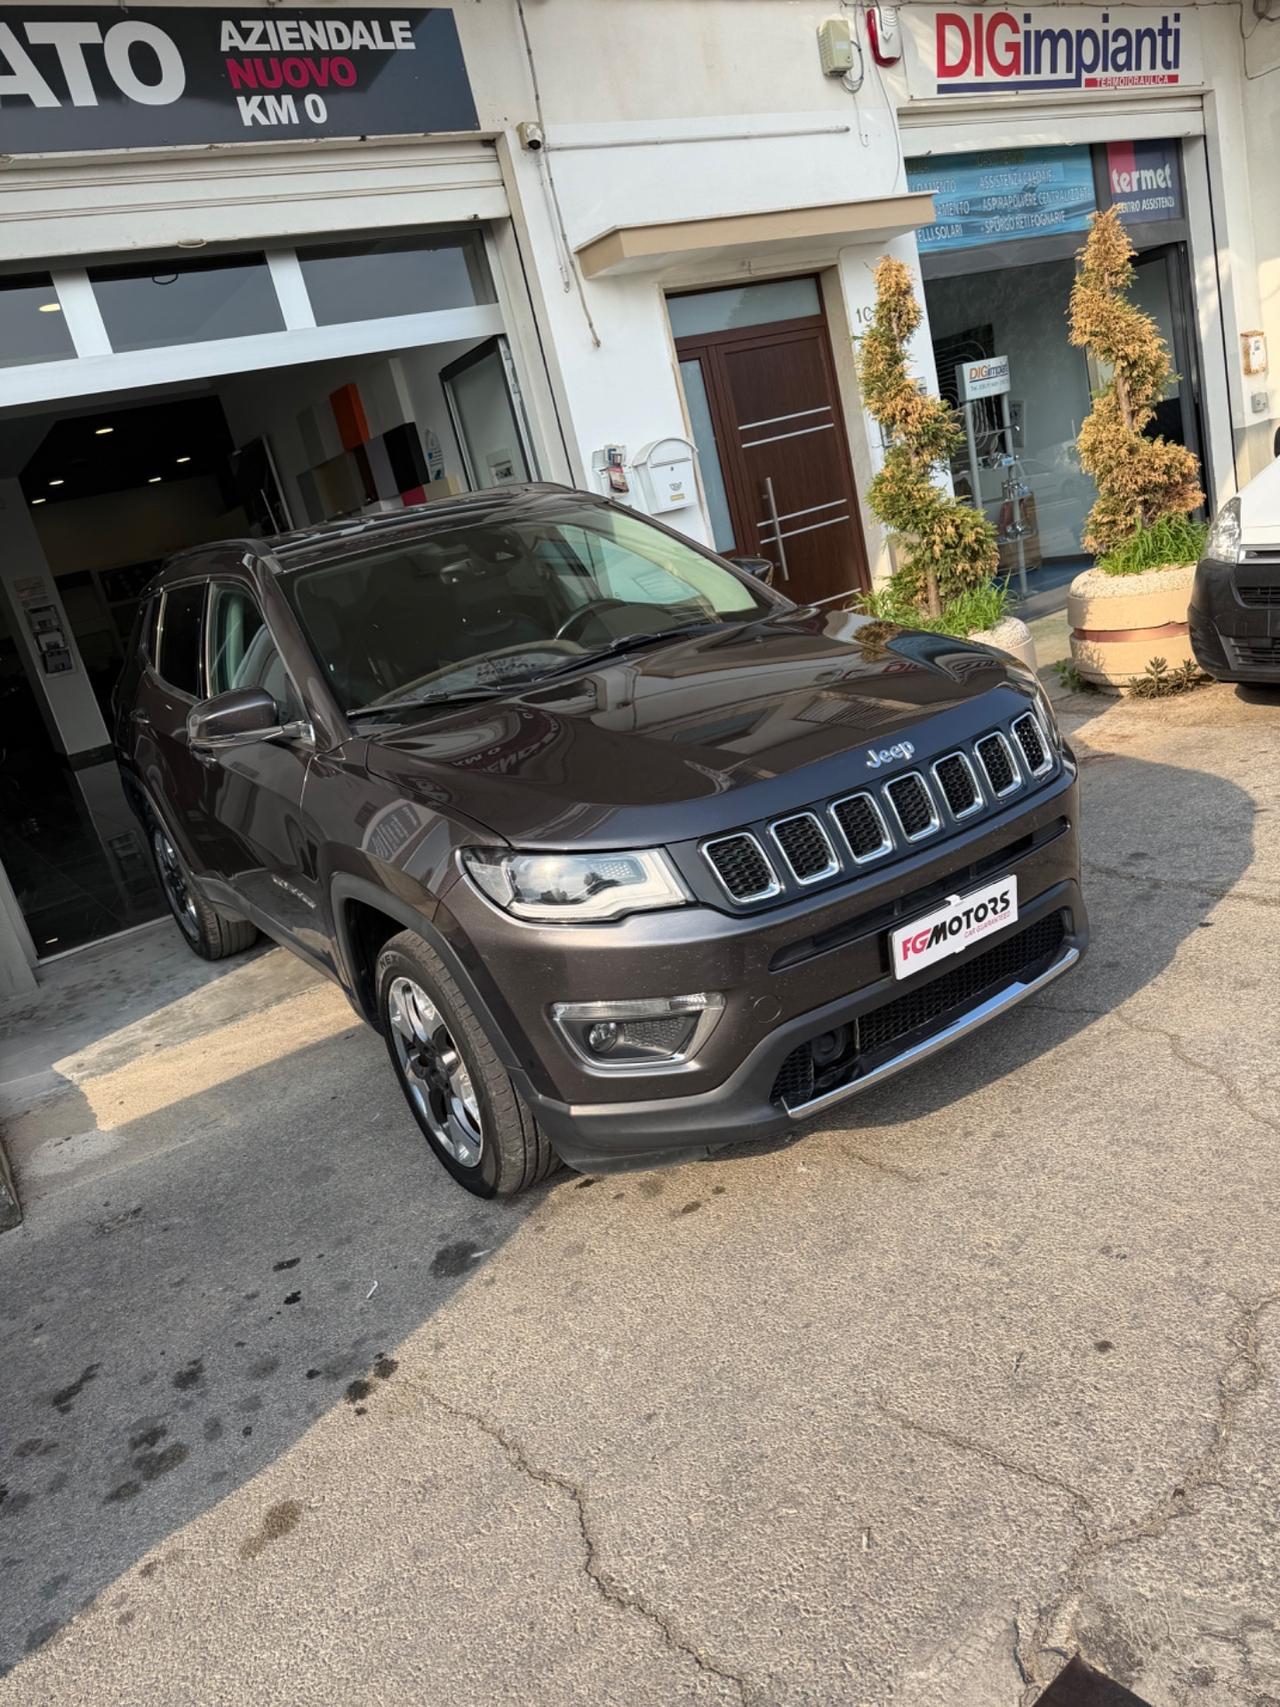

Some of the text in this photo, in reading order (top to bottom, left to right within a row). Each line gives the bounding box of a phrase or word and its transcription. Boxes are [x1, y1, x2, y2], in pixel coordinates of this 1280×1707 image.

[220, 19, 416, 52] AZIENDALE
[936, 12, 1180, 88] DIGimpianti
[226, 57, 358, 90] NUOVO
[1096, 75, 1169, 88] TERMOIDRAULICA
[236, 94, 328, 127] KM 0
[1112, 162, 1172, 193] termet
[985, 215, 1015, 234] SPURGO
[1030, 210, 1066, 228] FOGNARIE
[866, 740, 915, 768] Jeep
